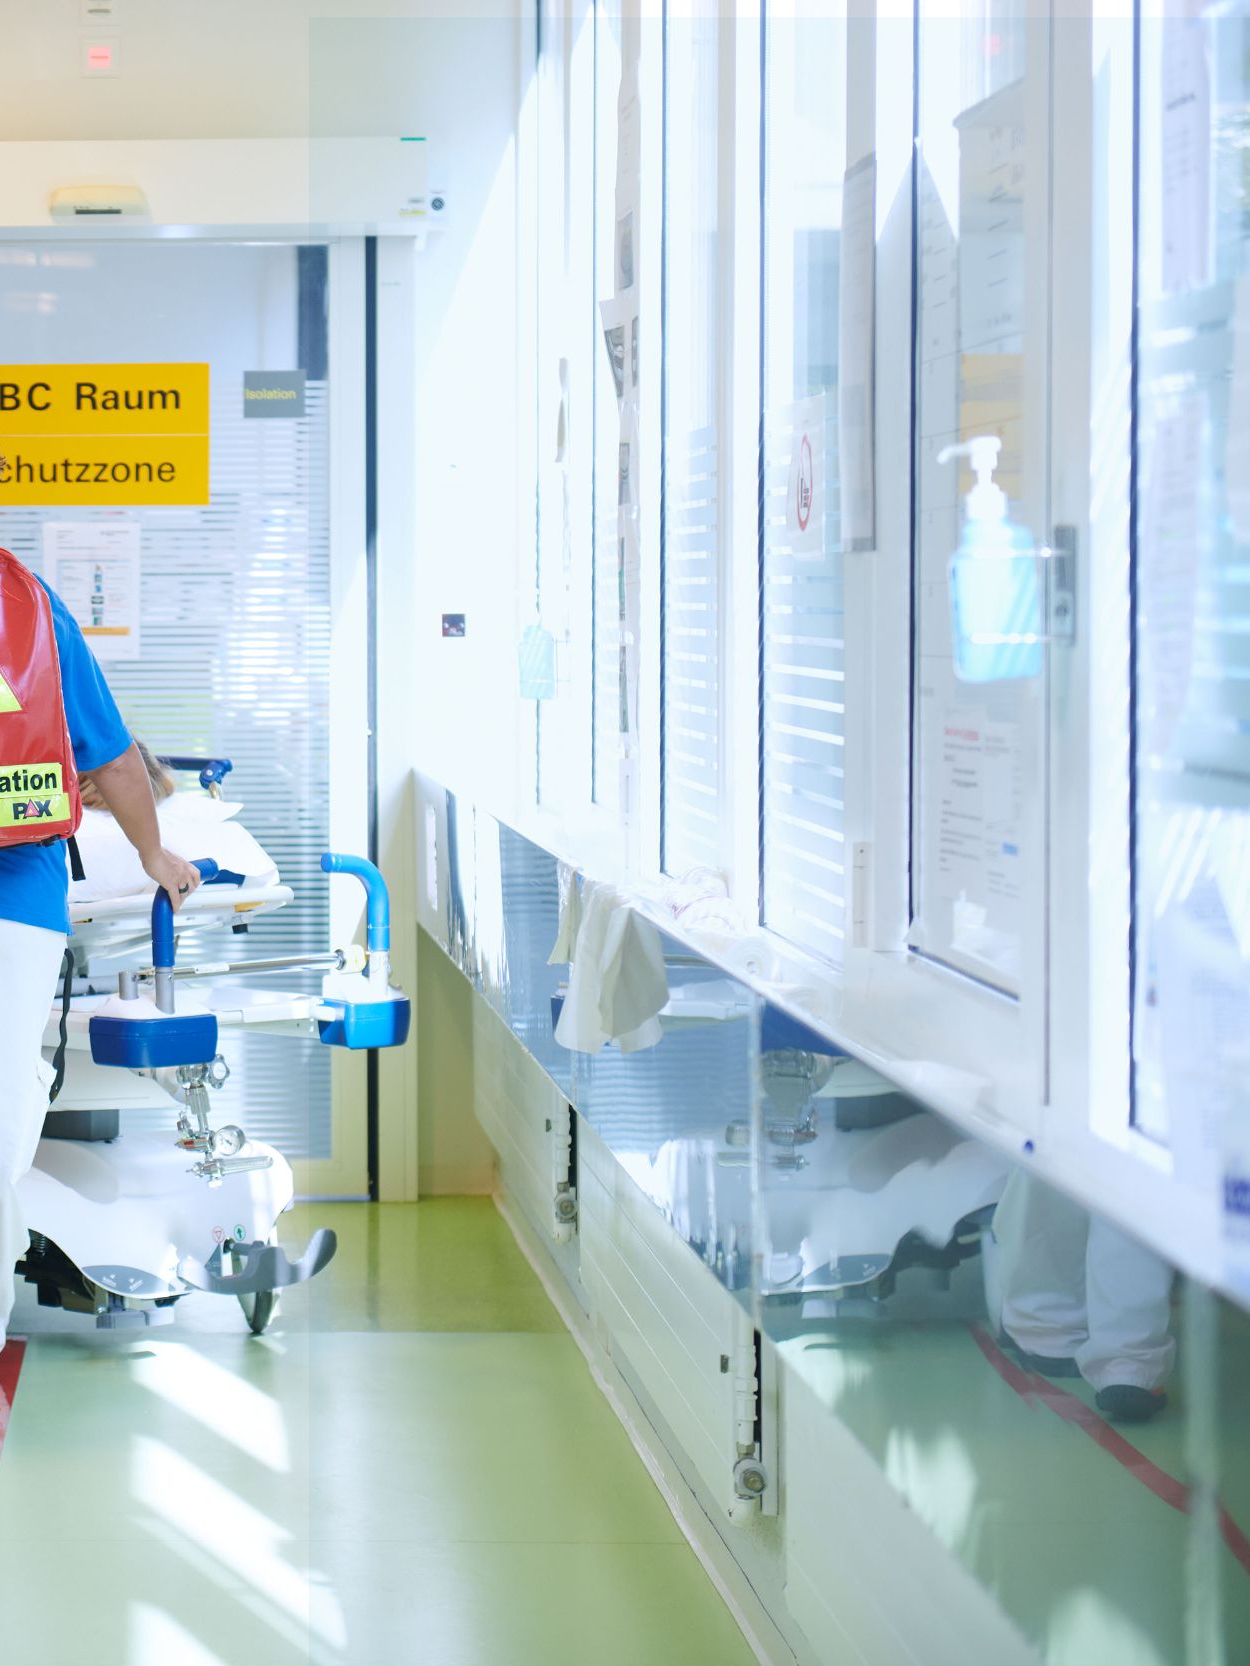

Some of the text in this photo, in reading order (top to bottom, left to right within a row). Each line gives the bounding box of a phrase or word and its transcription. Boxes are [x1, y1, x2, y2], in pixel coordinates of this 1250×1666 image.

[76, 382, 181, 411] Raum
[245, 387, 296, 400] Isolation
[12, 798, 52, 821] PAX
